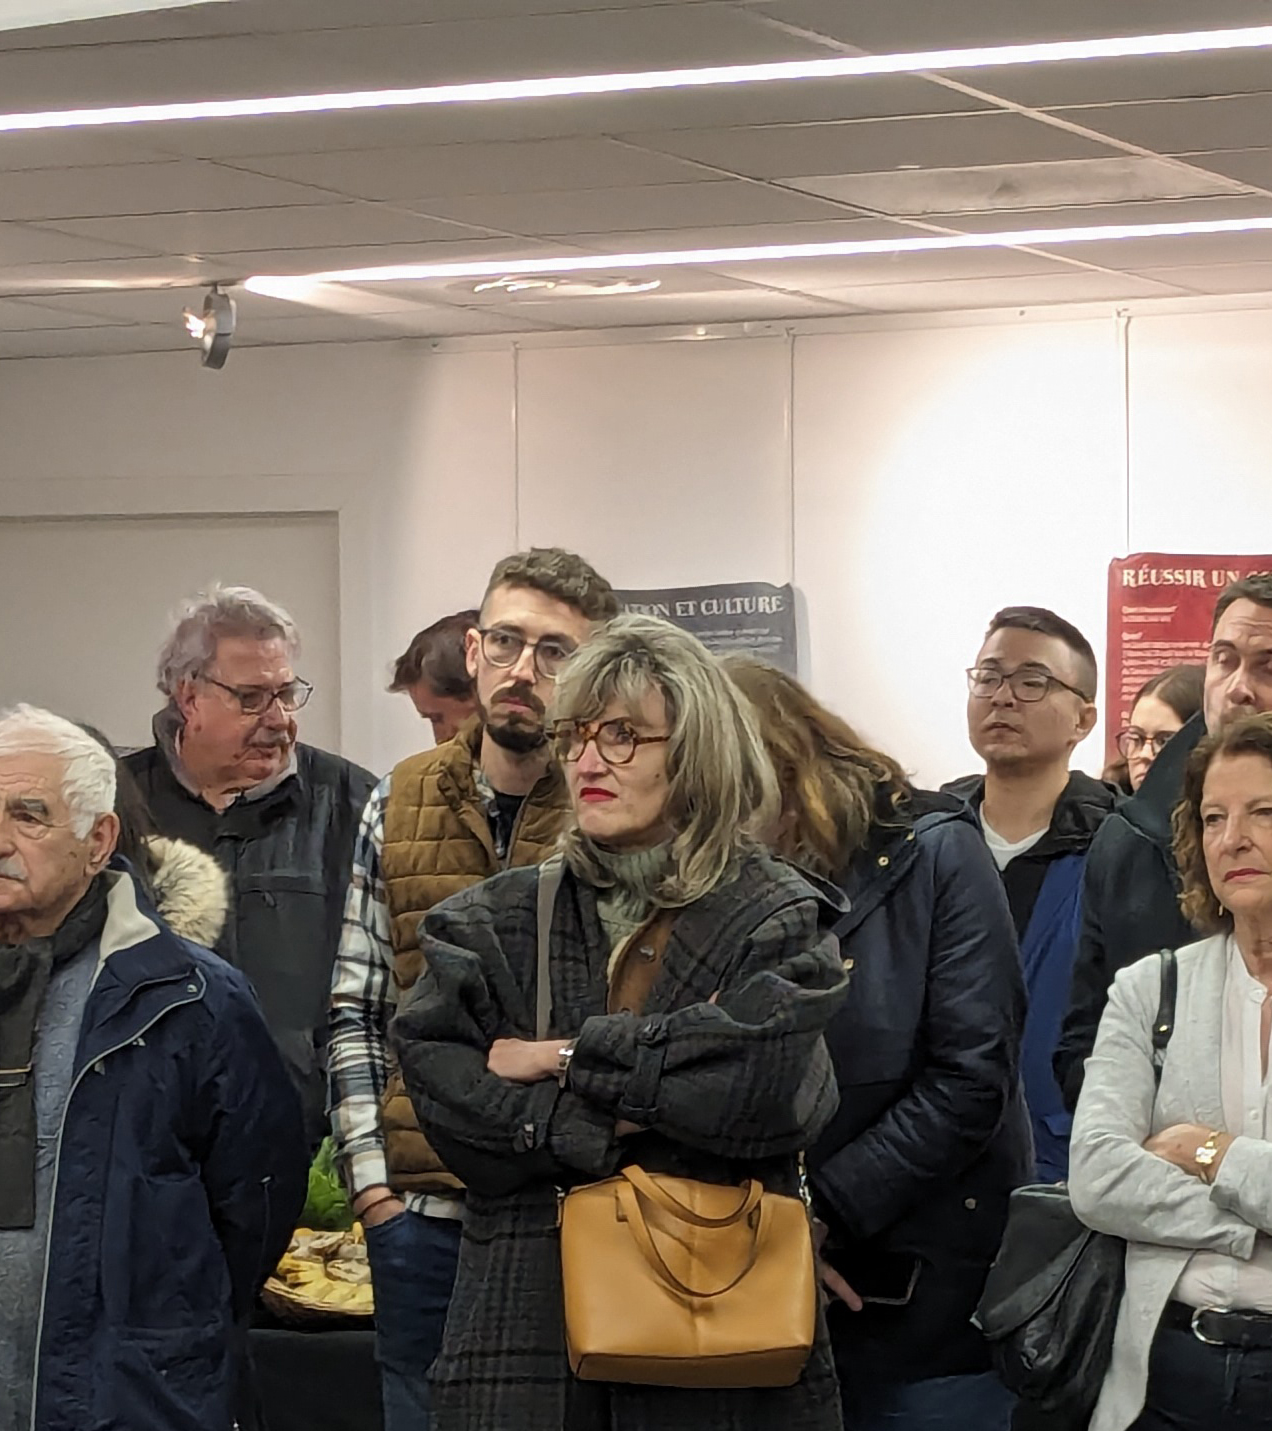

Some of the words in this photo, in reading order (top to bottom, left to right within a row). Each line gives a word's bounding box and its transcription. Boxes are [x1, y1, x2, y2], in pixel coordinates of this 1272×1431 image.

[1122, 564, 1208, 588] RÉUSSIR
[1211, 569, 1240, 587] UN
[675, 600, 697, 617] ET
[700, 595, 785, 616] CULTURE
